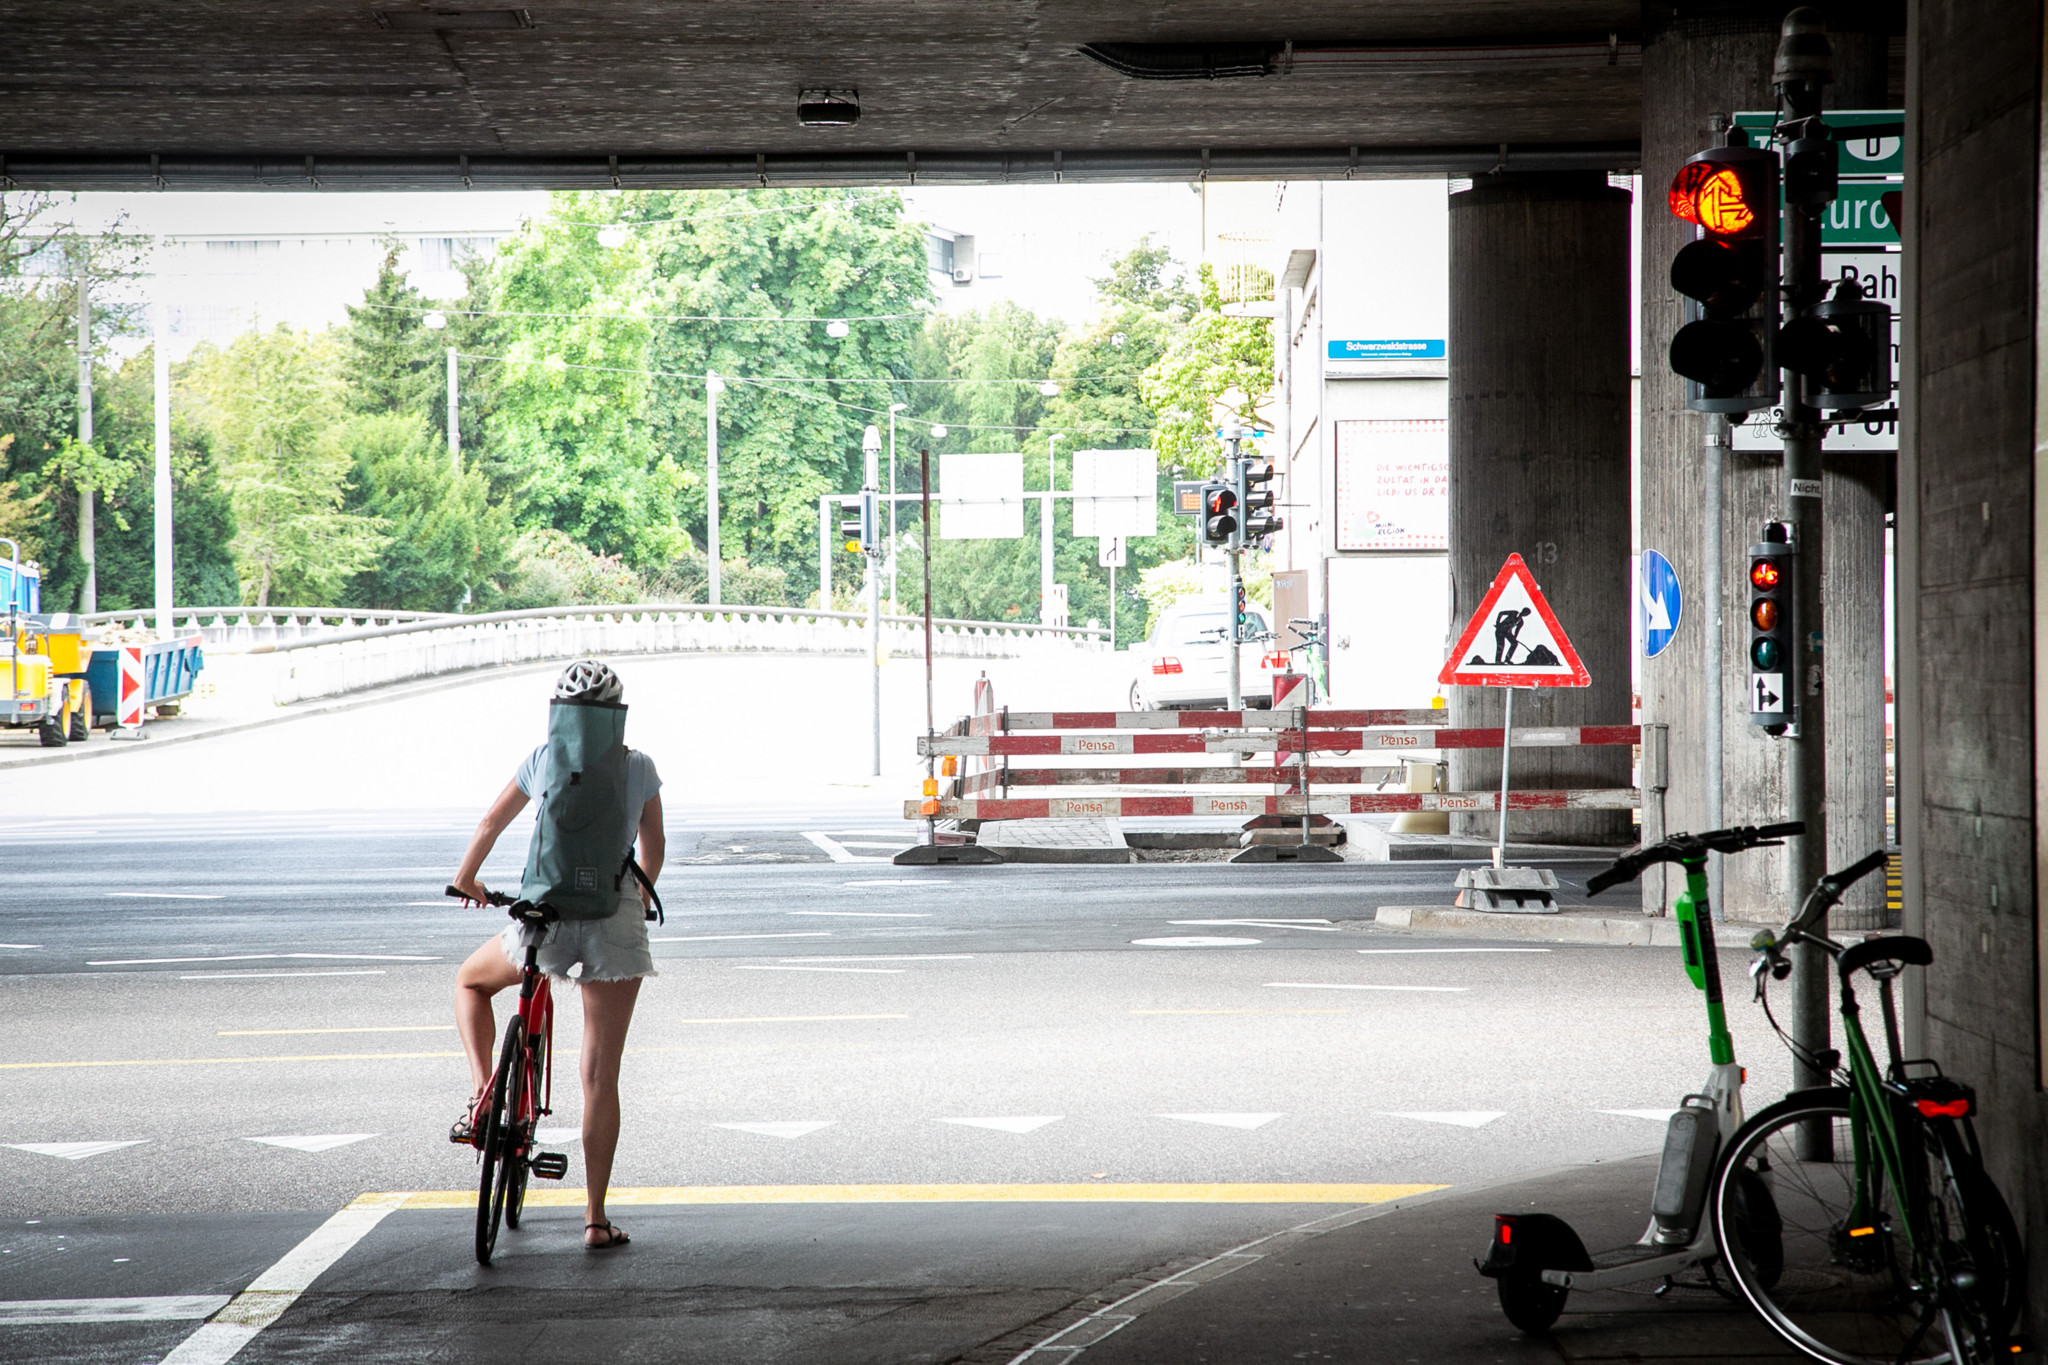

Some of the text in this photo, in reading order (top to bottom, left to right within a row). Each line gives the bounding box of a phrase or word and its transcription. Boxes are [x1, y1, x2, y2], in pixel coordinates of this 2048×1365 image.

[1821, 199, 1890, 229] uro
[1346, 341, 1427, 351] Schwarzwaldstrasse
[1536, 541, 1557, 564] 13
[1078, 739, 1115, 751] Pensa
[1380, 734, 1418, 746] Pensa
[1066, 802, 1103, 813] Pensa
[1210, 799, 1248, 811] Pensa
[1439, 797, 1477, 808] Pensa
